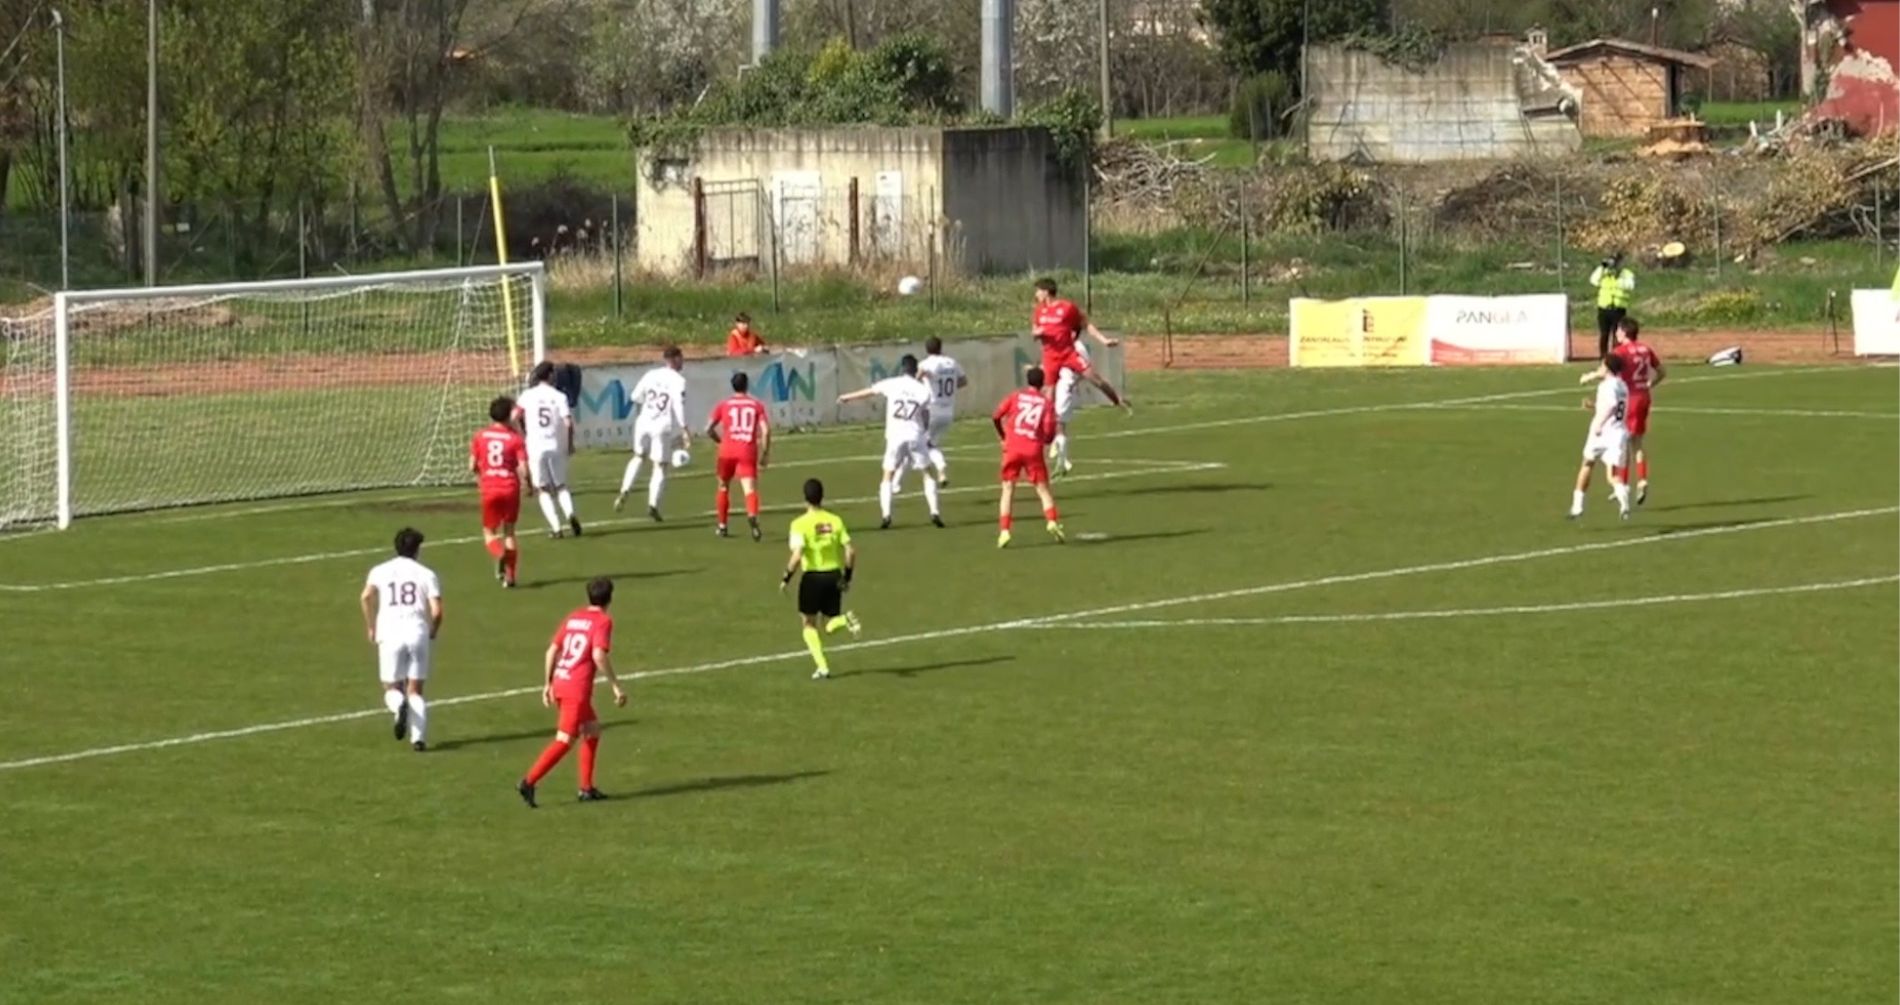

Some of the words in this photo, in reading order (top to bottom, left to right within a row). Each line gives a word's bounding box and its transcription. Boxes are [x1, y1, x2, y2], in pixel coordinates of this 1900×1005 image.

[647, 389, 669, 411] 23
[937, 378, 954, 397] 10
[538, 407, 551, 428] 5
[728, 406, 756, 432] 10
[893, 400, 919, 420] 27
[1014, 402, 1043, 430] 74
[487, 440, 504, 467] 8
[388, 581, 417, 606] 18
[558, 633, 588, 668] 19
